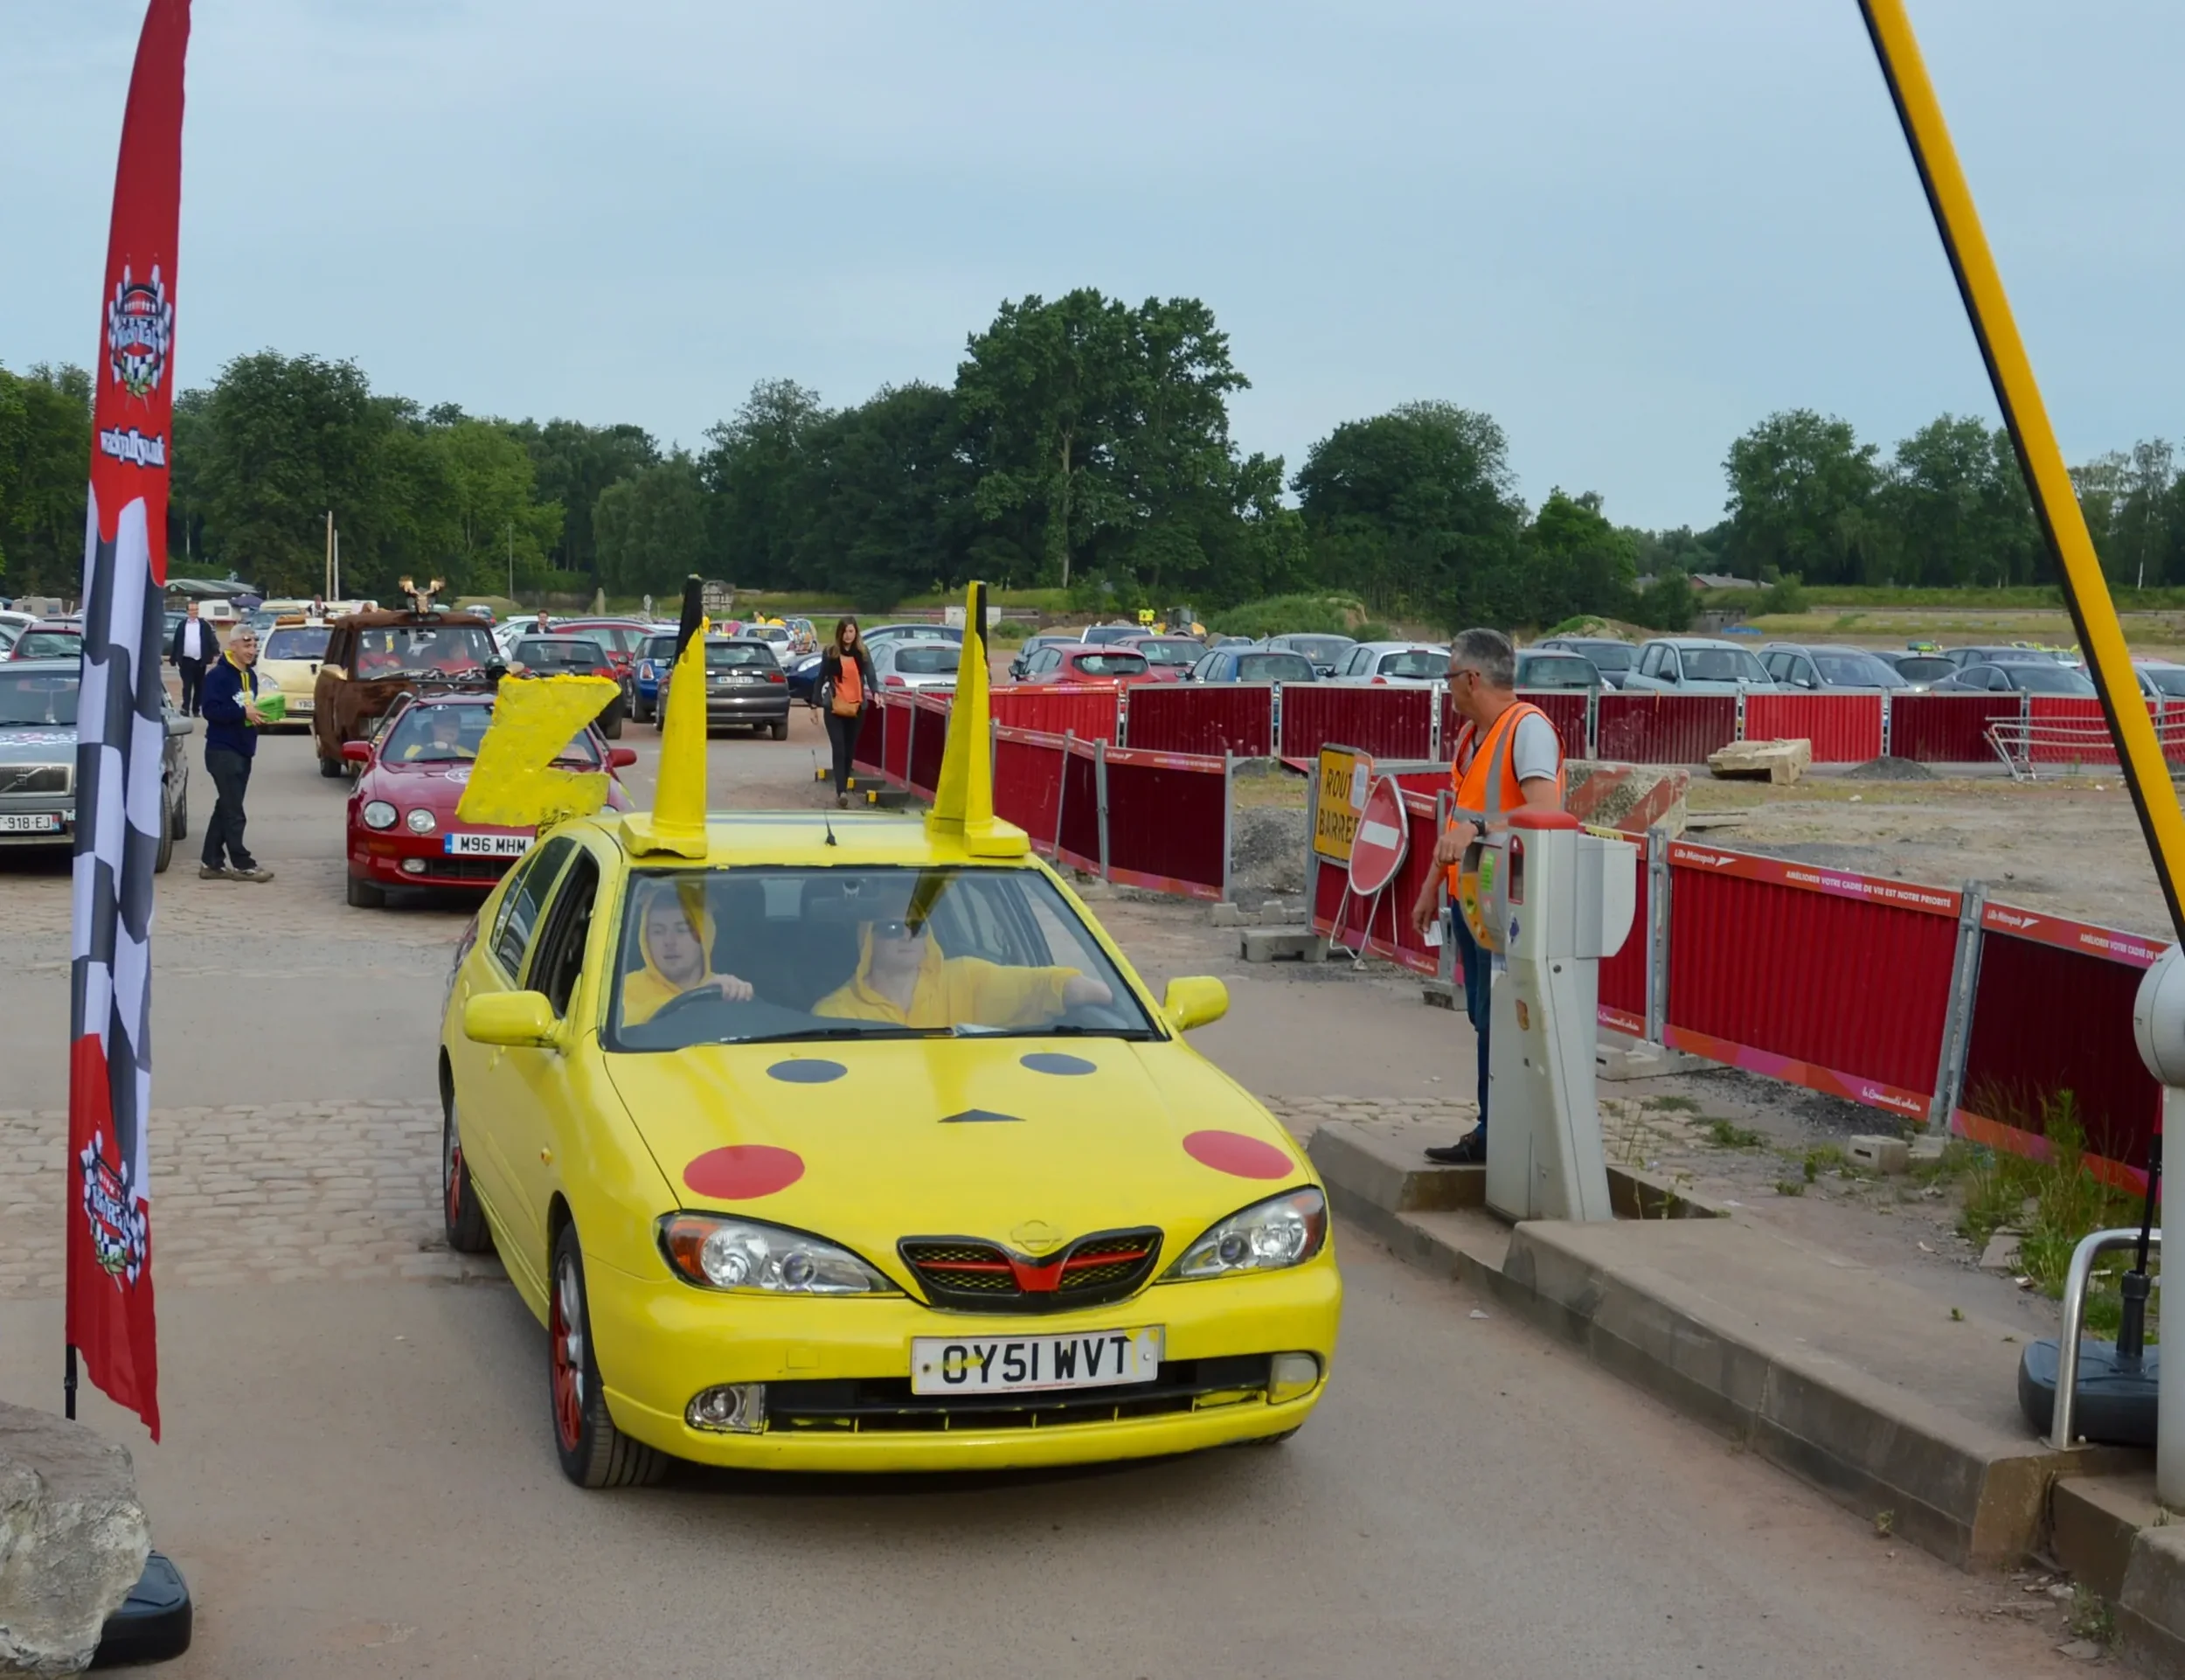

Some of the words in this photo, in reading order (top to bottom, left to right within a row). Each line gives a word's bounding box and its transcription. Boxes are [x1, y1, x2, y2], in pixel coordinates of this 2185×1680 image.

[1325, 768, 1353, 800] ROUT
[0, 816, 51, 830] -918-EJ
[460, 837, 491, 852] M96
[496, 838, 526, 854] MHM
[1821, 877, 1841, 887] VOTRE
[1863, 884, 1872, 893] DE
[1874, 885, 1884, 895] VIE
[1884, 888, 1897, 898] EST
[1897, 891, 1920, 902] NOTRE
[942, 1343, 1039, 1385] OY51
[1054, 1336, 1133, 1379] WVT
